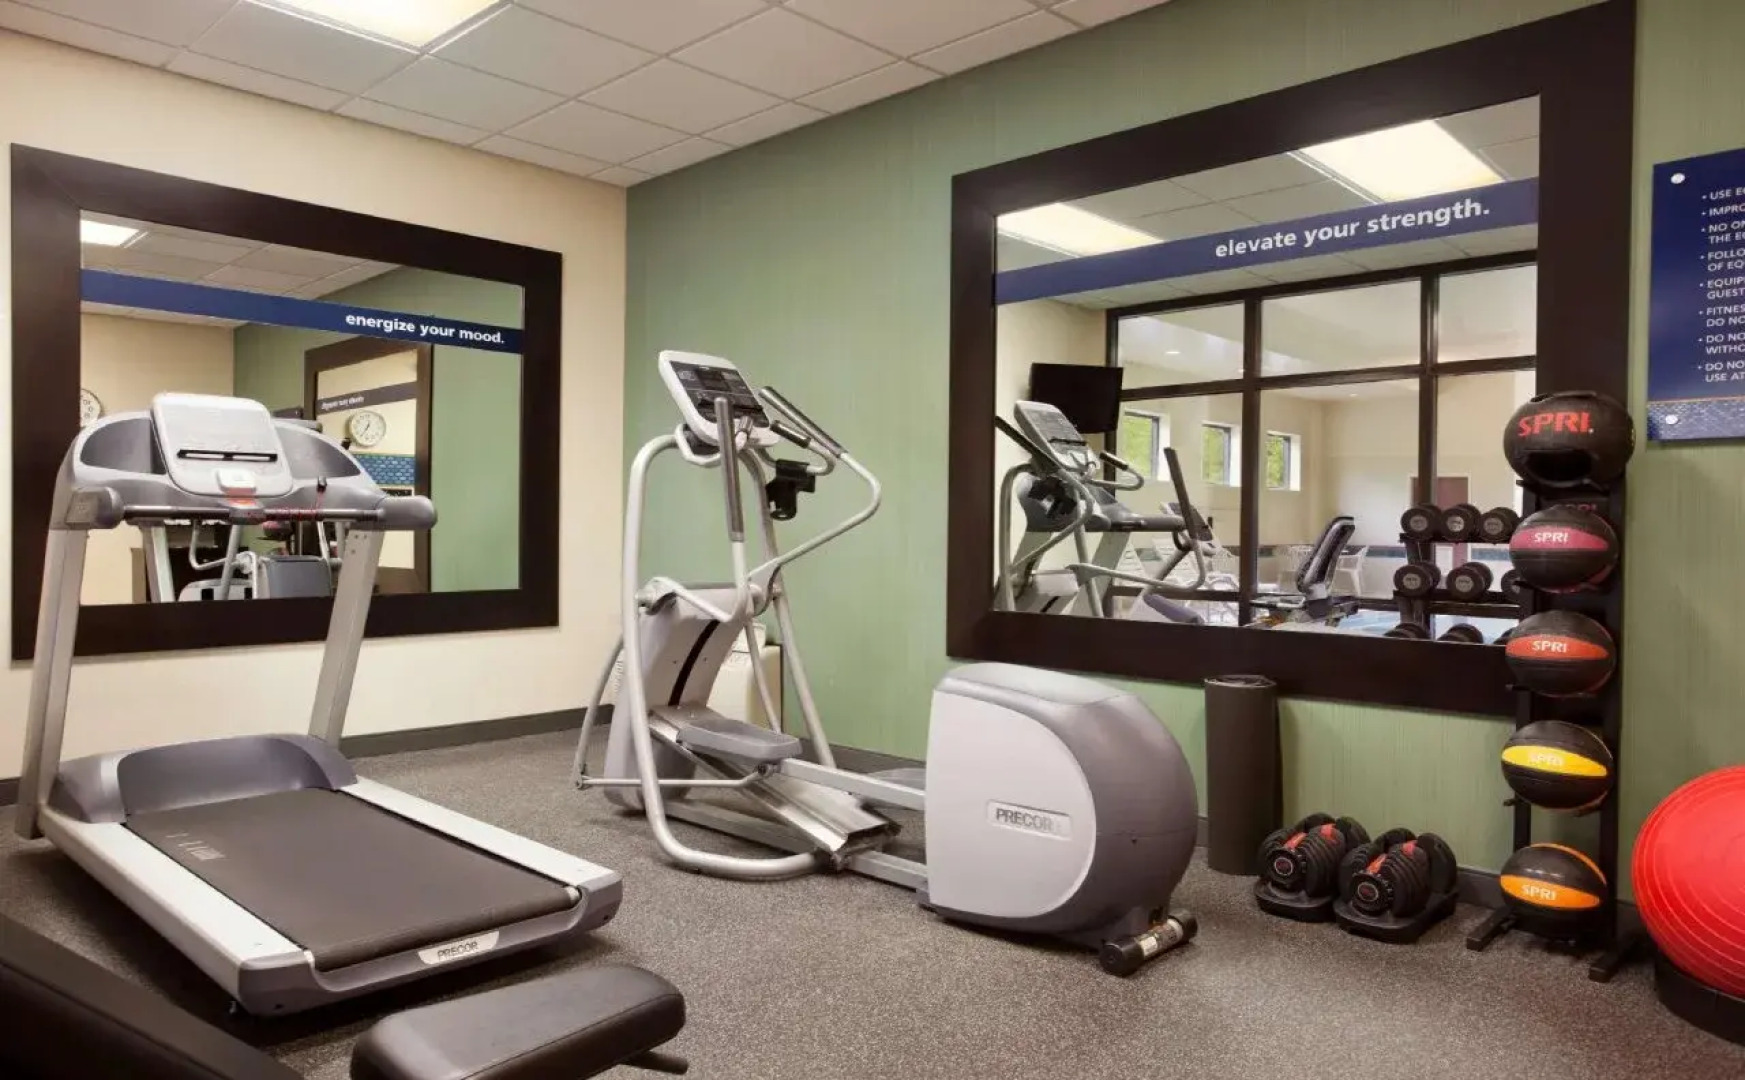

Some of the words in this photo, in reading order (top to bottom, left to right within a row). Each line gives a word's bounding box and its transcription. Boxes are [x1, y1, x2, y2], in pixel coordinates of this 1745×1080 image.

[1709, 189, 1732, 200] USE
[1215, 231, 1298, 257] elevate
[1303, 221, 1360, 247] your
[1366, 198, 1490, 233] strength.
[1708, 223, 1728, 233] NO
[1708, 233, 1731, 244] THE
[1707, 248, 1745, 260] FOLLO
[1707, 261, 1724, 271] OF
[1707, 276, 1745, 289] EQUIP
[1707, 287, 1745, 300] GUEST
[1706, 318, 1726, 327] DO
[1728, 315, 1745, 326] NO
[345, 314, 415, 332] energize
[419, 325, 456, 337] your
[458, 330, 505, 344] mood.
[1706, 334, 1725, 343] DO
[1728, 332, 1745, 342] NO
[1705, 362, 1724, 371] DO
[1726, 360, 1745, 370] NO
[1705, 373, 1727, 383] USE
[1534, 532, 1569, 544] SPRI
[1532, 640, 1567, 653] SPRI
[996, 808, 1053, 834] PRECOR
[1521, 884, 1557, 901] SPRI
[437, 941, 479, 960] PRECOR
